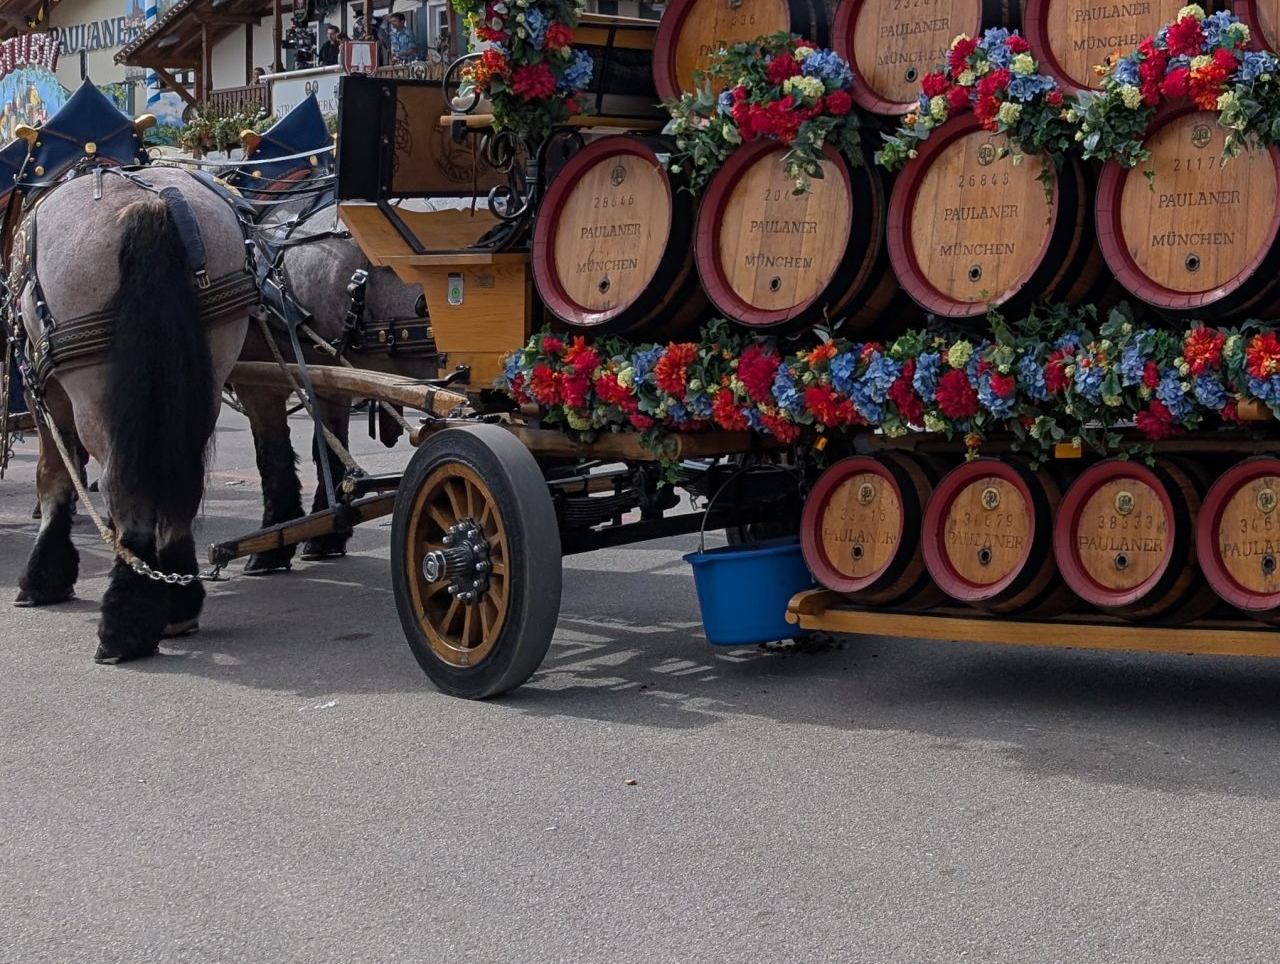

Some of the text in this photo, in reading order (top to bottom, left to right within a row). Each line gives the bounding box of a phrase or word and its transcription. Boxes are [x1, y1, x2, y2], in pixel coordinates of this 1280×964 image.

[1074, 2, 1151, 22] PAULANER
[880, 18, 951, 37] PAULANER
[1158, 190, 1241, 209] PAULANER
[944, 204, 1019, 221] PAULANER
[580, 223, 642, 239] PAULANER
[750, 220, 818, 234] PAULANER
[1151, 231, 1235, 247] MÜNCHEN
[940, 242, 1015, 257] MÜNCHEN
[576, 258, 638, 274] MÜNCHEN
[744, 253, 813, 269] MÜNCHEN
[823, 527, 894, 545] PAULANR
[1079, 536, 1163, 552] PAULANER
